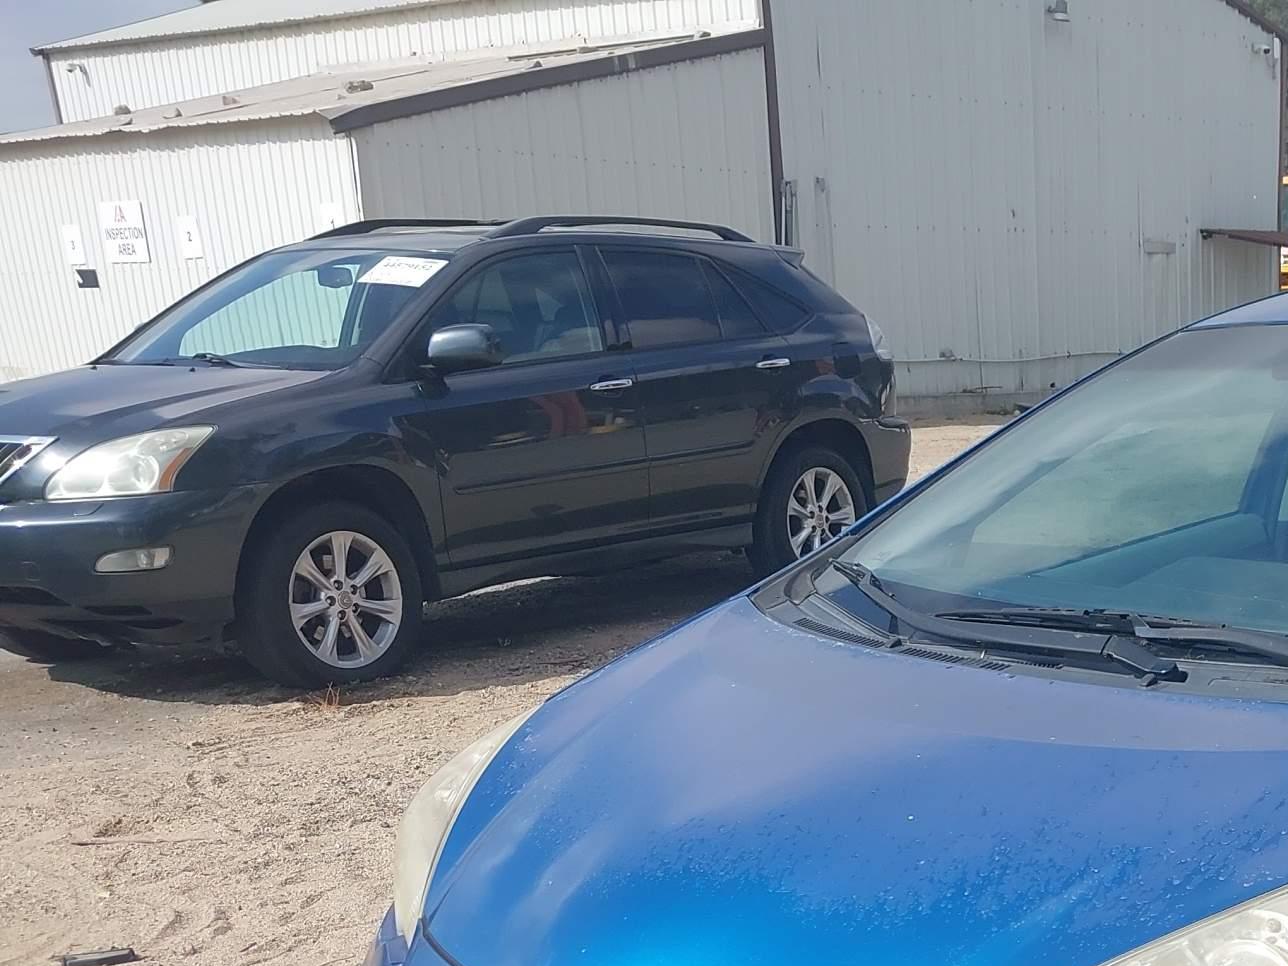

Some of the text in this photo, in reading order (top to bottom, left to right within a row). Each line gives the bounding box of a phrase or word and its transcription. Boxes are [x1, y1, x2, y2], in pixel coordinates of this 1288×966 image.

[105, 227, 144, 240] INSPECTION
[186, 231, 193, 242] 2
[118, 243, 136, 255] AREA
